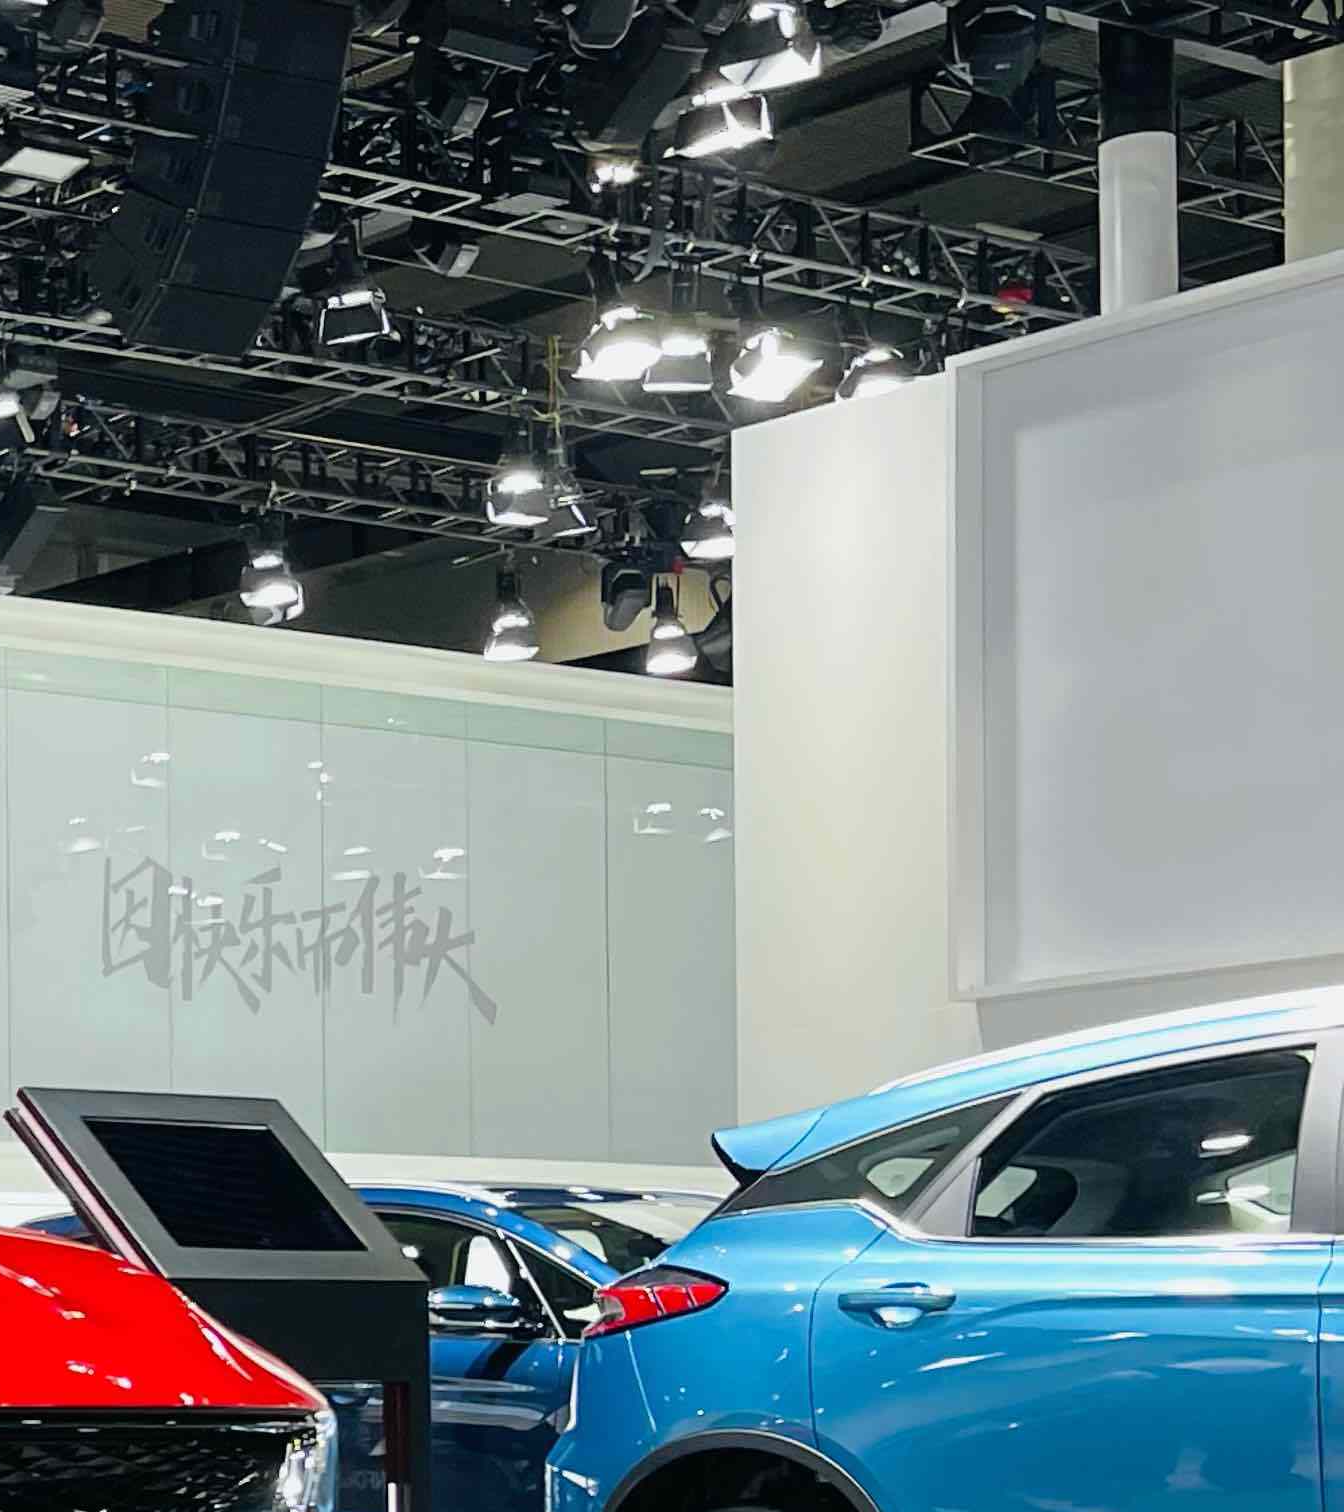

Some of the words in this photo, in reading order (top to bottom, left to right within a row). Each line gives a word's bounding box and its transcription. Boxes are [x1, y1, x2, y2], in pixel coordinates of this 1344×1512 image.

[101, 855, 498, 1027] 因快乐而伟大
